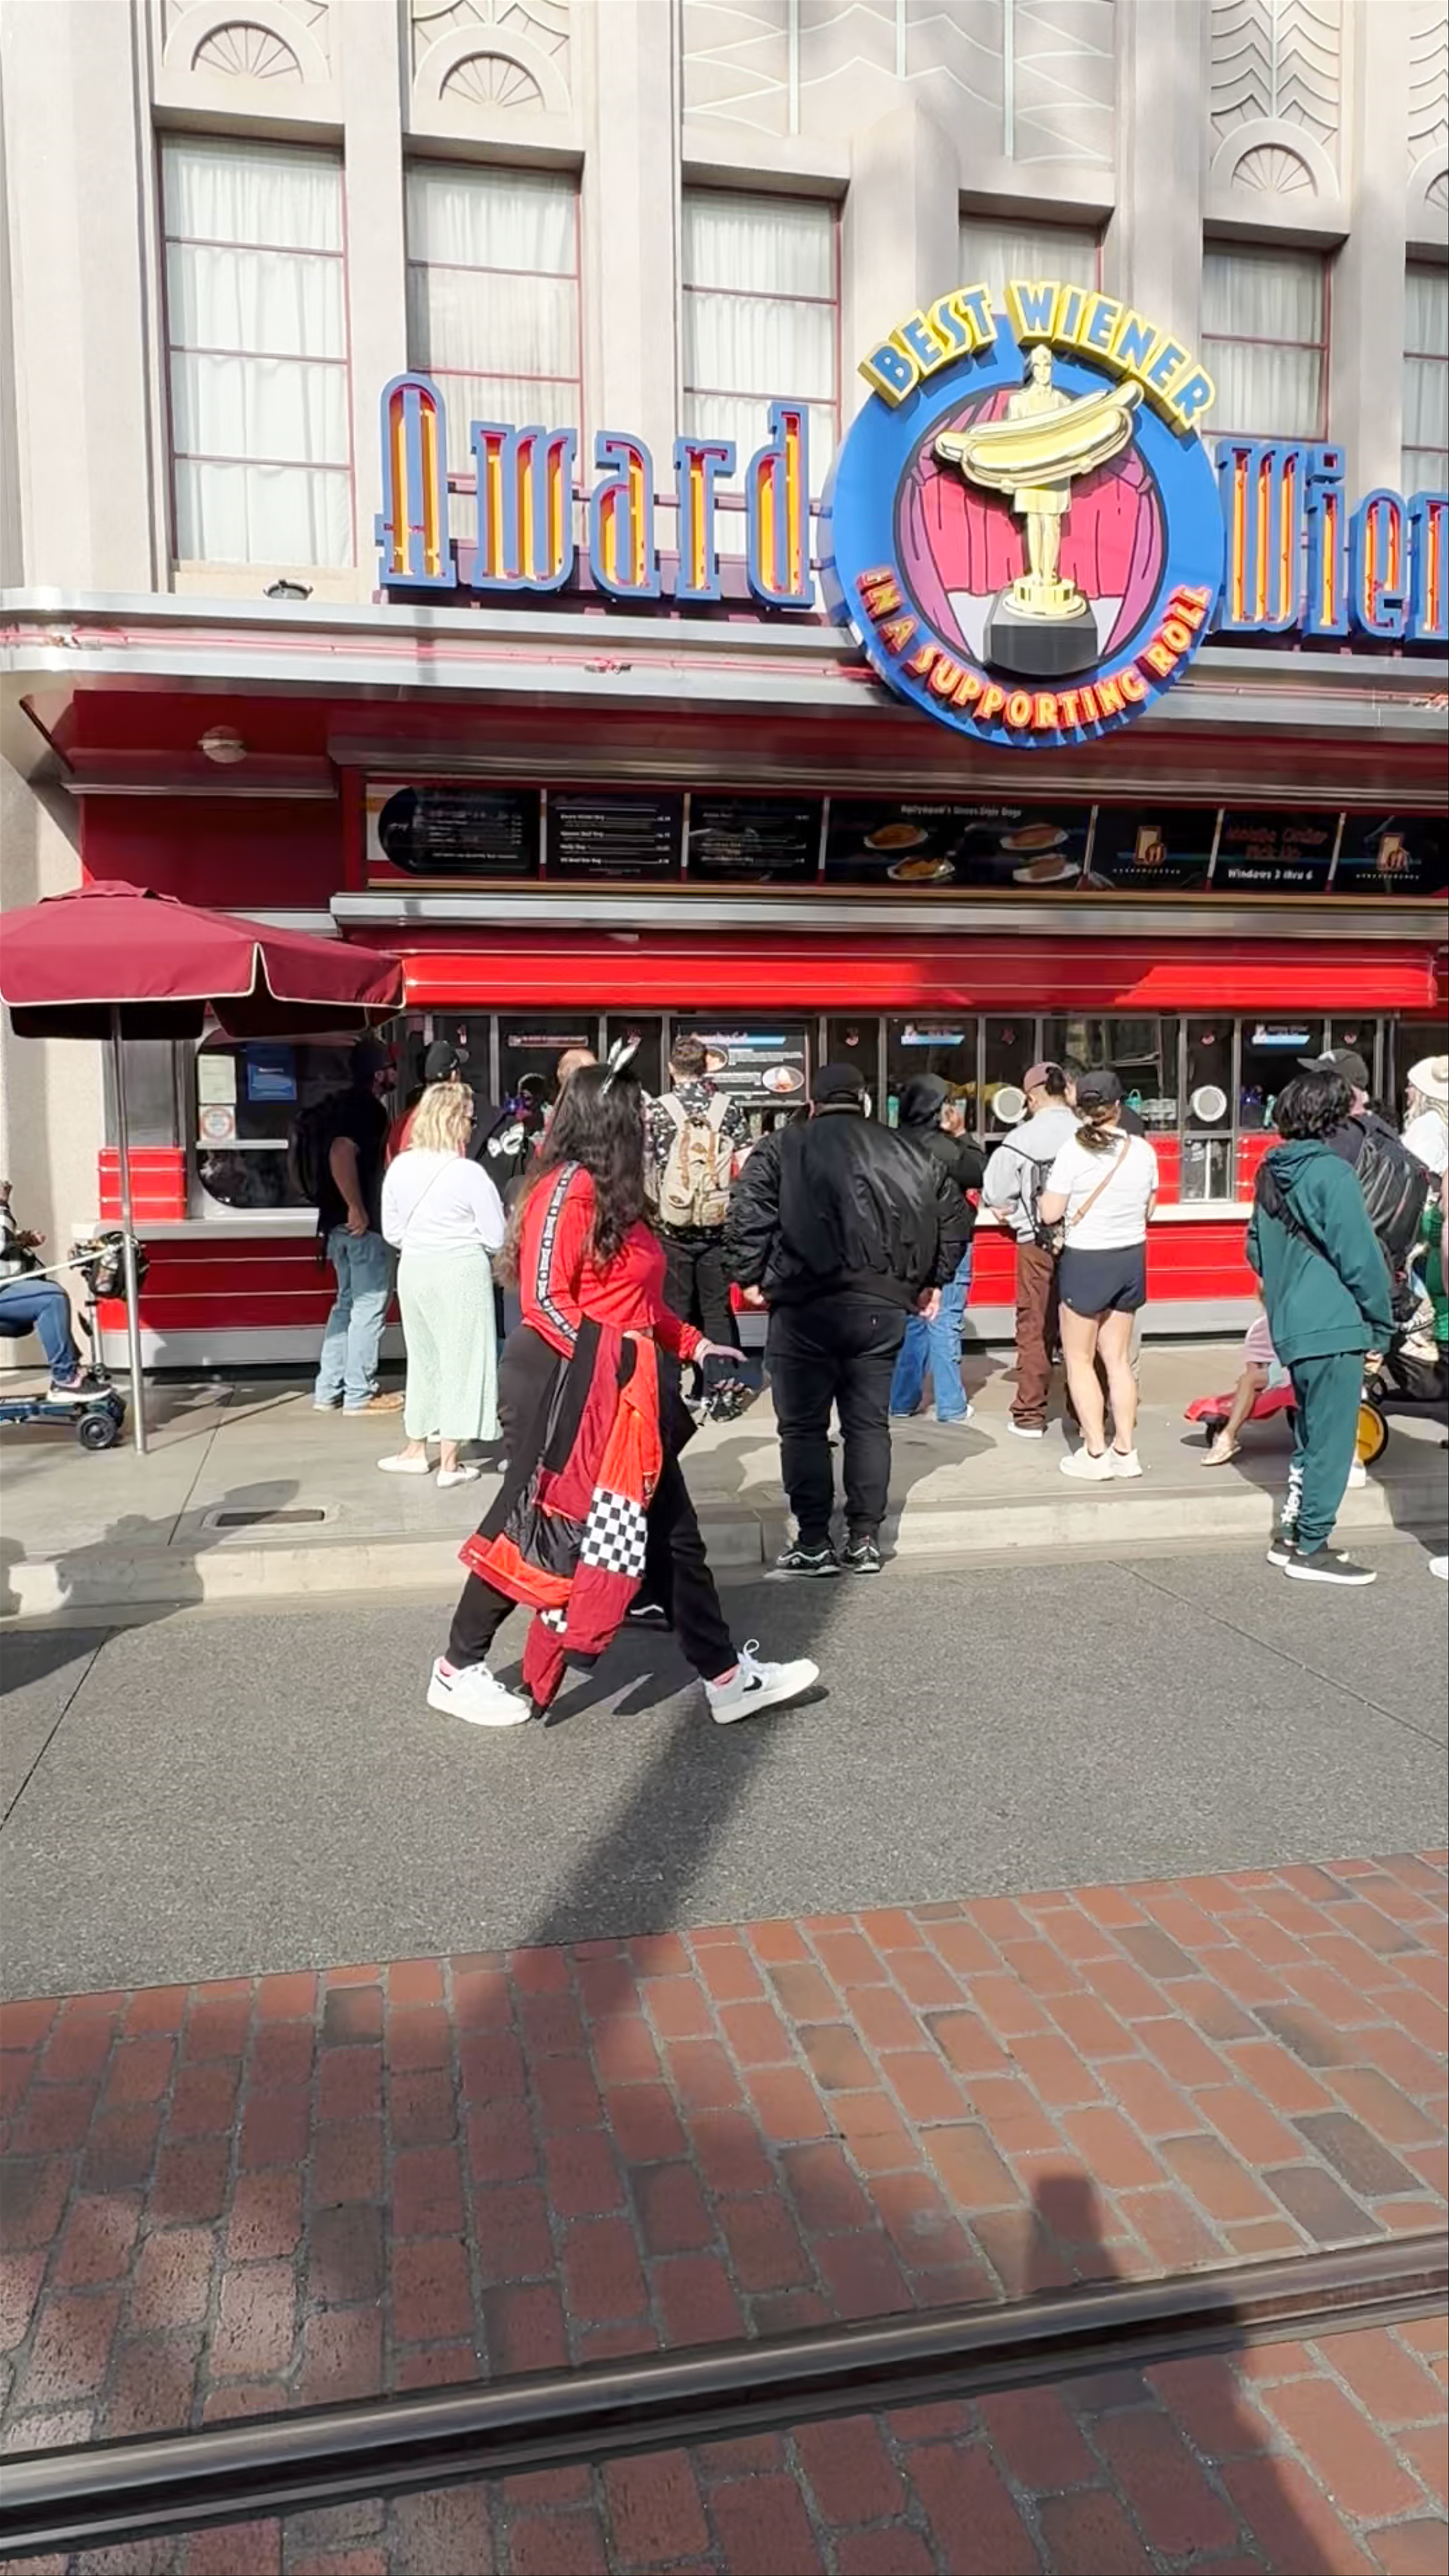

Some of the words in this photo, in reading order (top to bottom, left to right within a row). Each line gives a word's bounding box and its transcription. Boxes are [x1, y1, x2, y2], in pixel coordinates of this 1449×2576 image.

[857, 282, 998, 408] BEST
[1003, 280, 1216, 435] WIENER
[375, 373, 815, 608] Award
[856, 568, 902, 622] IN
[877, 615, 918, 656] A
[1135, 584, 1212, 678] ROLL
[903, 642, 1149, 729] SUPPORTING
